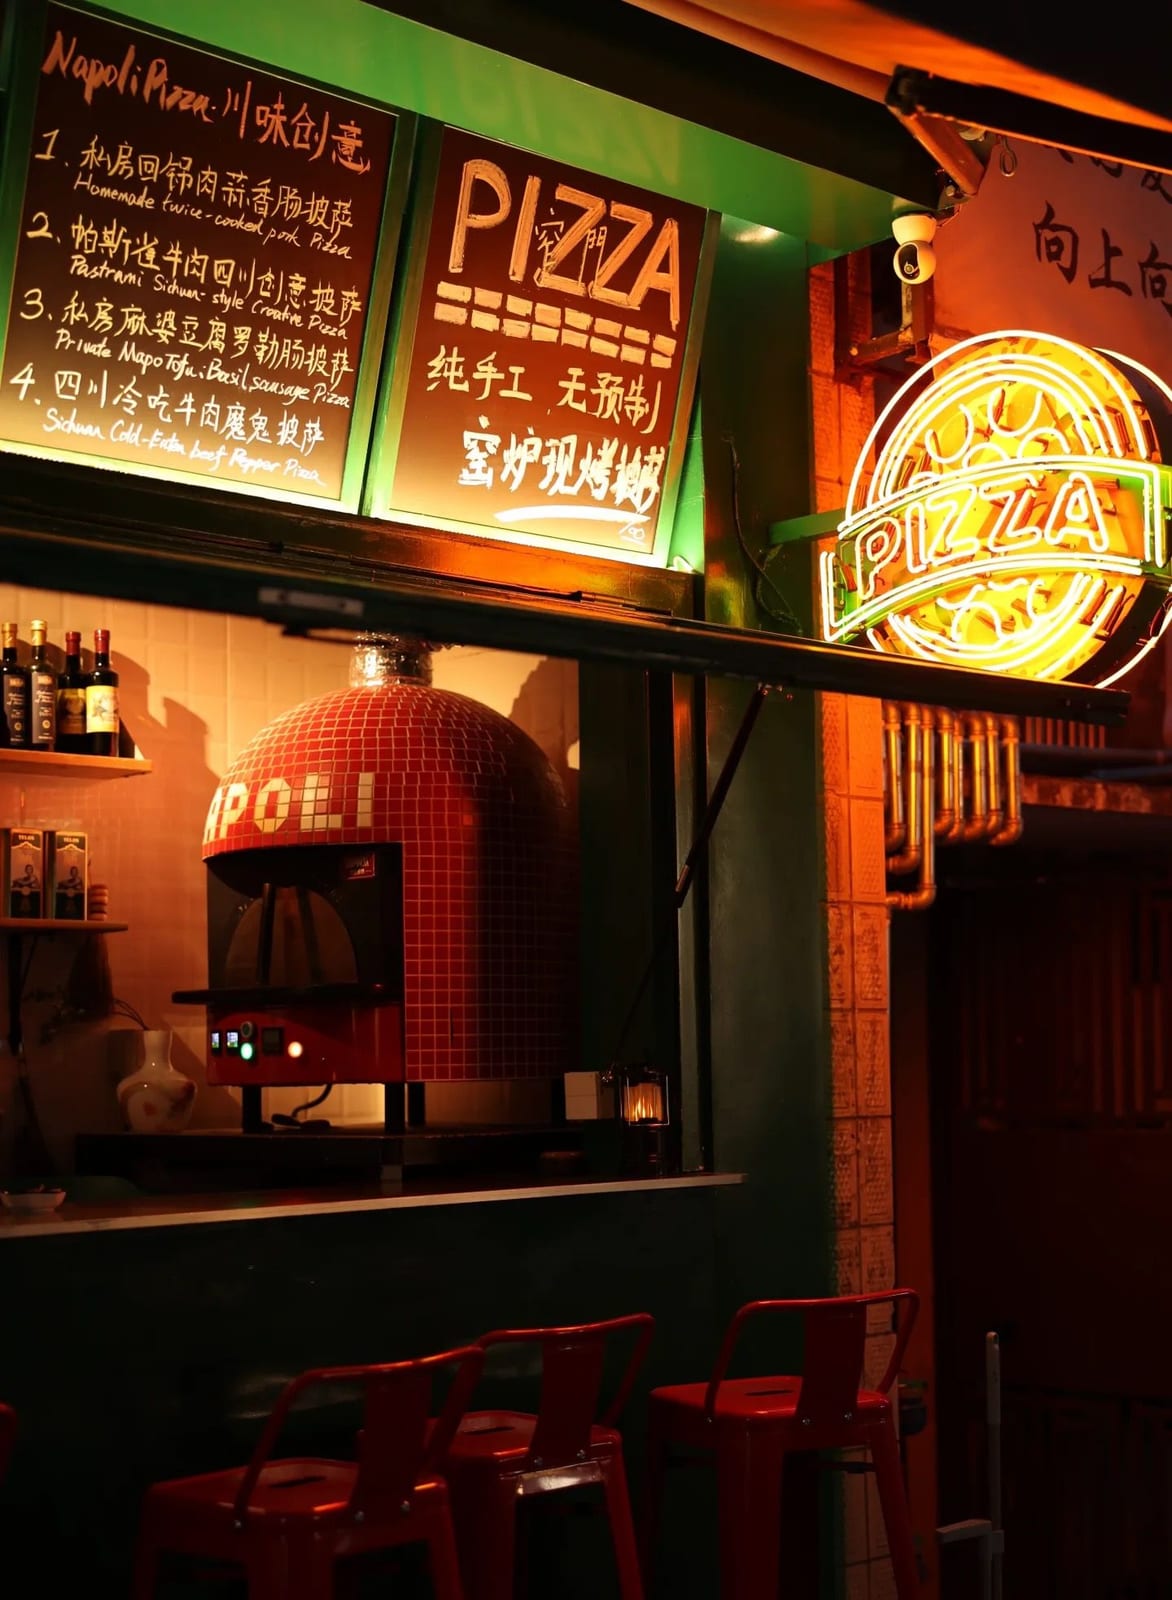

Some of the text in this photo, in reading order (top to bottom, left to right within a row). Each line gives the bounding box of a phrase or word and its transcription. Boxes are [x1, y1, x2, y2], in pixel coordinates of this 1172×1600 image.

[41, 30, 142, 106] Napoli
[222, 81, 371, 175] 川味创意
[74, 172, 155, 209] Homemade
[263, 226, 300, 247] pork
[310, 232, 352, 259] Pizza
[448, 158, 680, 331] PIZZA
[61, 290, 354, 391] 私房麻婆豆腐罗勒肠披萨
[70, 254, 145, 287] Pastrami
[308, 315, 348, 340] Pizza
[55, 328, 112, 358] Private
[118, 341, 163, 375] Mapo
[250, 376, 310, 405] sausage
[313, 382, 350, 408] Pizza
[426, 345, 662, 433] 纯手工 无预制
[43, 408, 105, 440] Sichuan
[55, 369, 324, 457] 四川冷吃牛肉魔鬼披萨
[854, 470, 1110, 600] PIZZA
